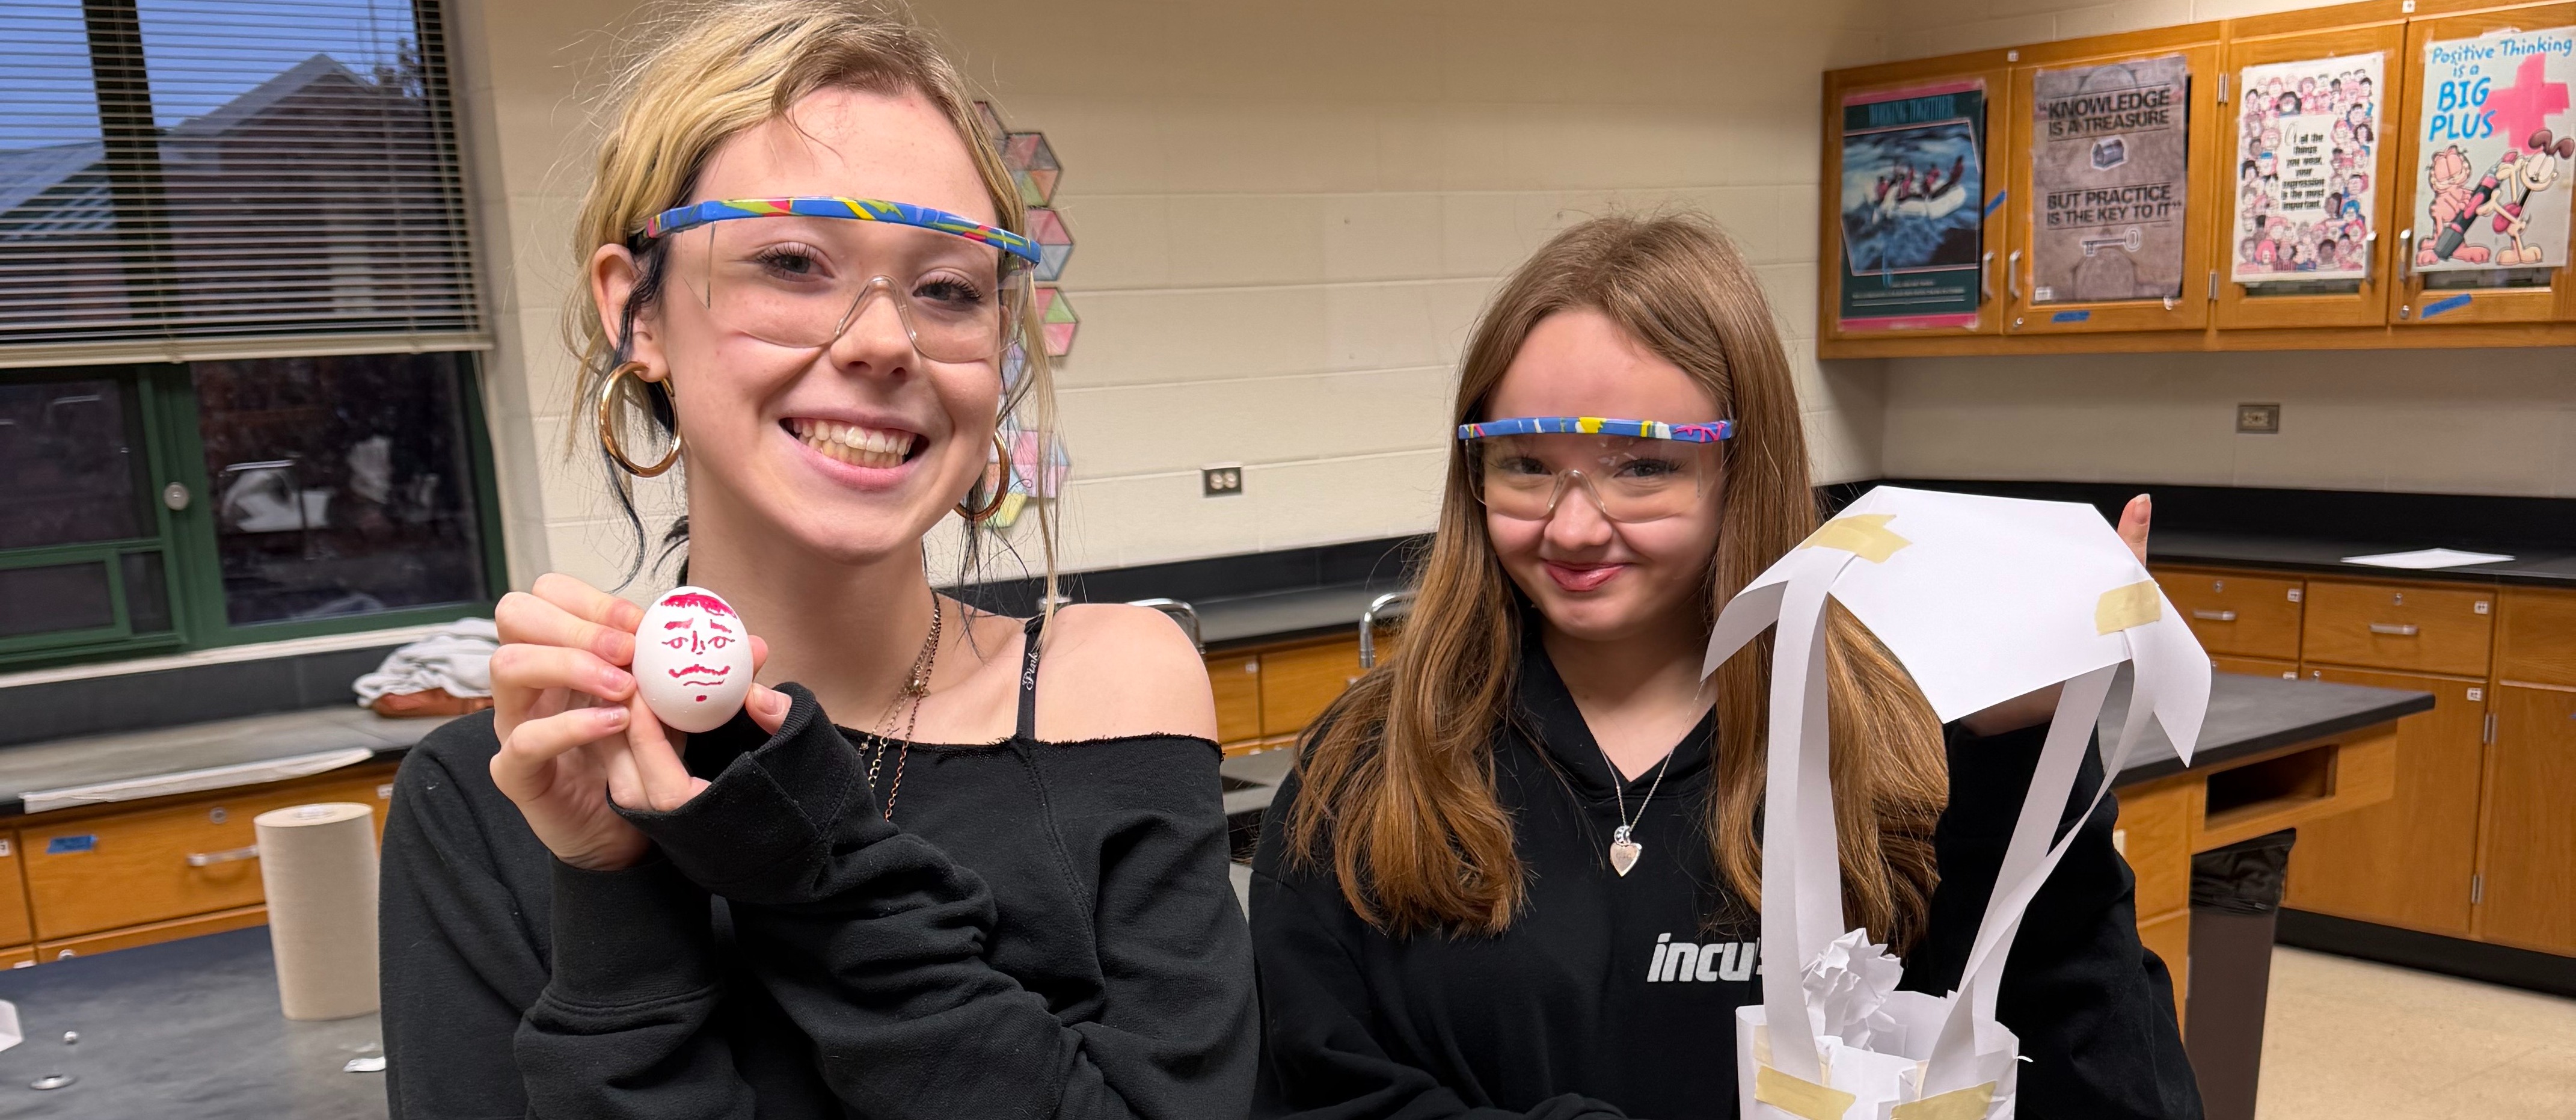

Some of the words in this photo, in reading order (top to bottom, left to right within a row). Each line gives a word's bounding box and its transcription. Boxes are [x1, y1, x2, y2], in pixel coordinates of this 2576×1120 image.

[2432, 45, 2495, 64] Positive
[2500, 35, 2572, 57] Thinking
[2453, 62, 2465, 78] is
[2470, 65, 2479, 75] a
[2437, 76, 2491, 112] BIG
[2048, 121, 2063, 137] IS
[2067, 120, 2079, 135] A
[2083, 109, 2170, 131] TREASURE
[2428, 109, 2497, 142] PLUS
[2047, 193, 2081, 210] BUT
[2085, 185, 2171, 206] PRACTICE
[2047, 212, 2061, 226] IS
[2065, 209, 2093, 225] THE
[2097, 206, 2129, 221] KEY
[2133, 204, 2153, 218] TO
[1022, 652, 1038, 691] Pink
